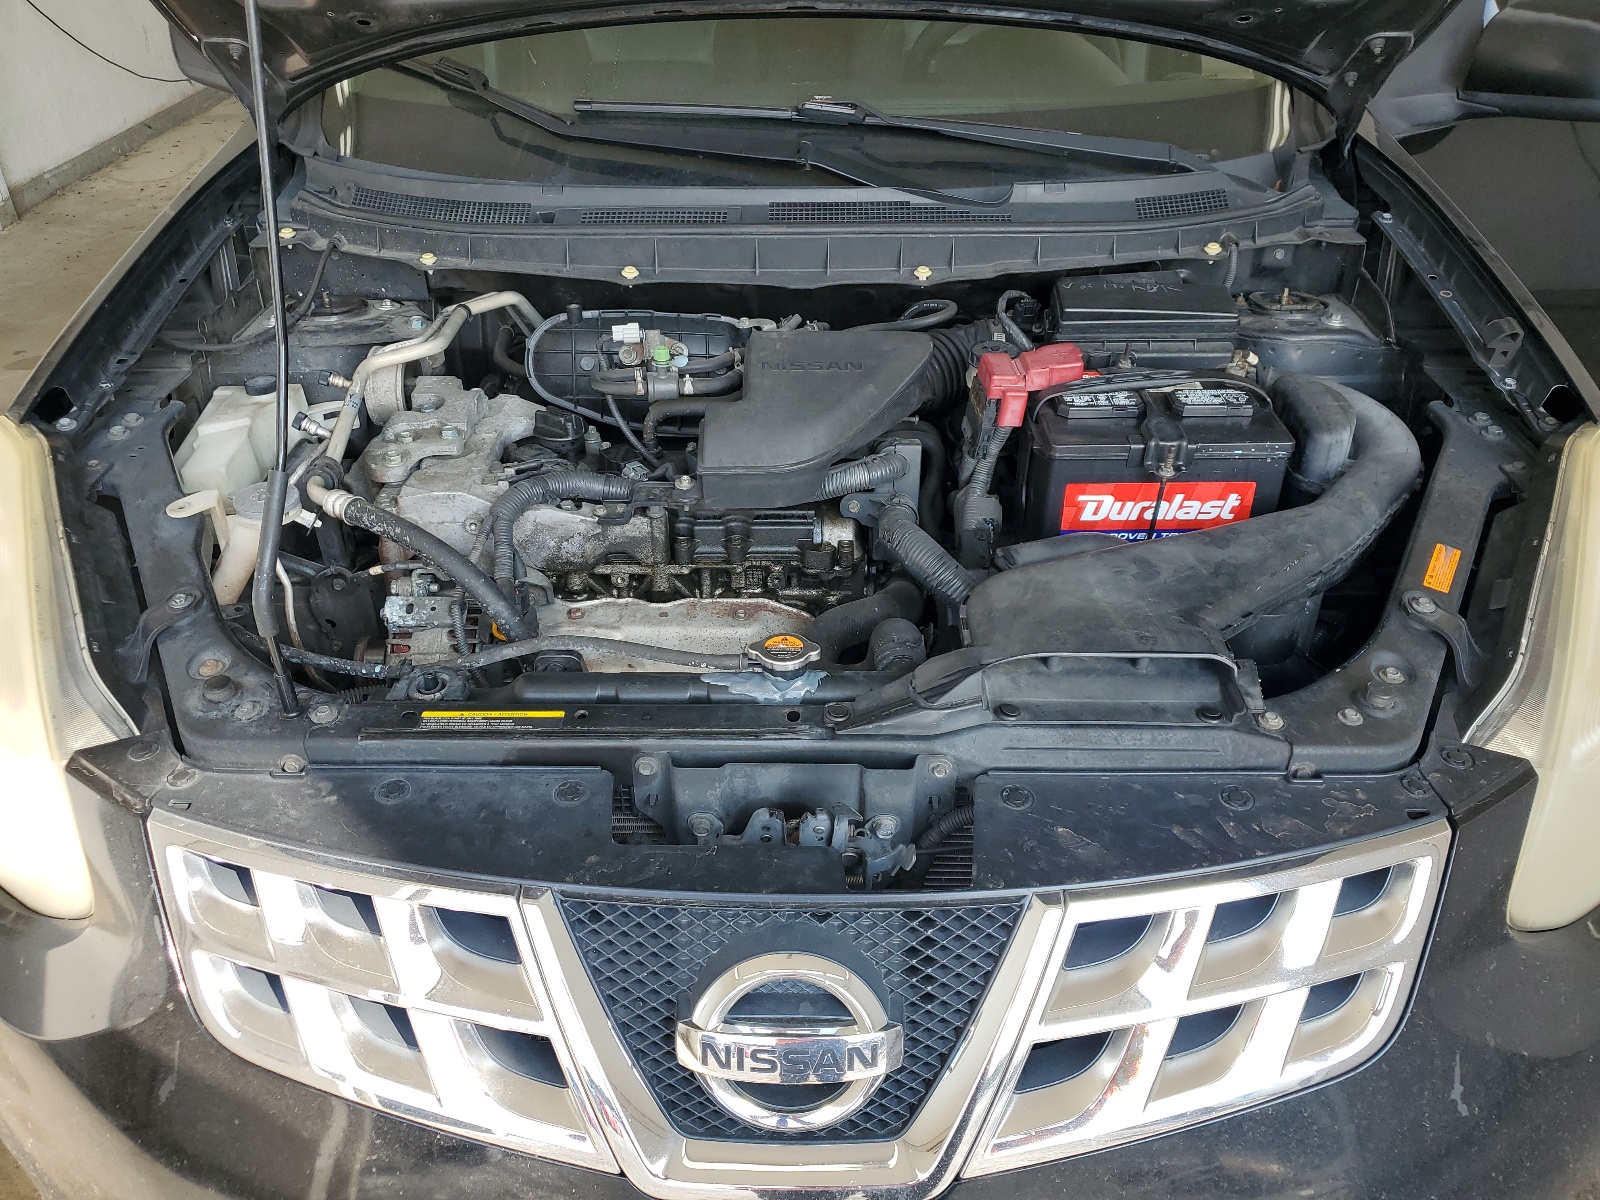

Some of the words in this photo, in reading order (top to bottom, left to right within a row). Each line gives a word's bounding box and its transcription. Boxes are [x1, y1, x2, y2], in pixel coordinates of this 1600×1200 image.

[761, 361, 864, 372] NISSAN
[1077, 493, 1240, 521] Duralast
[701, 1041, 880, 1075] NISSAN
